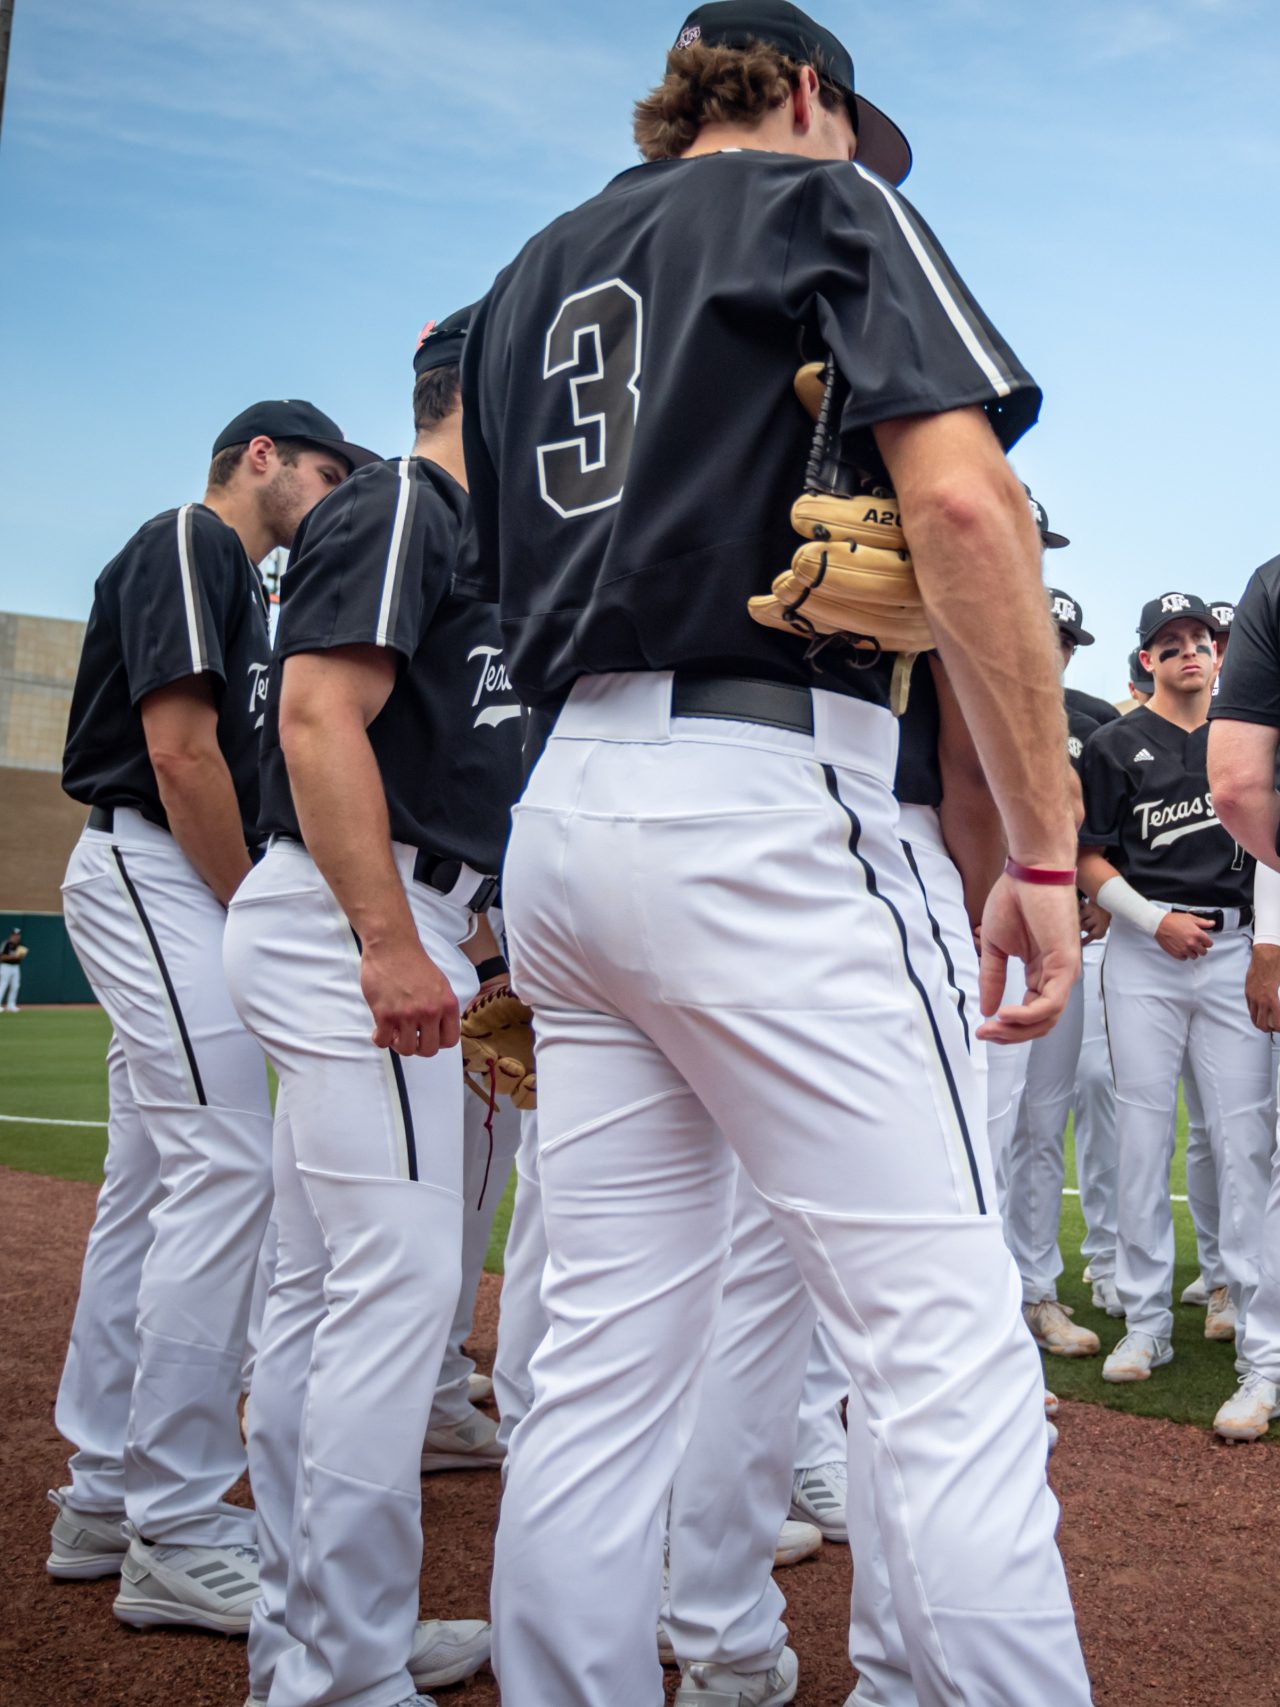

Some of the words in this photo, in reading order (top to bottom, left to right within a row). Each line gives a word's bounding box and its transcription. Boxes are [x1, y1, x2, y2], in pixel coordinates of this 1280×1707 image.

[536, 278, 642, 519] 3
[467, 645, 513, 708] Tex
[1133, 798, 1203, 840] Texas
